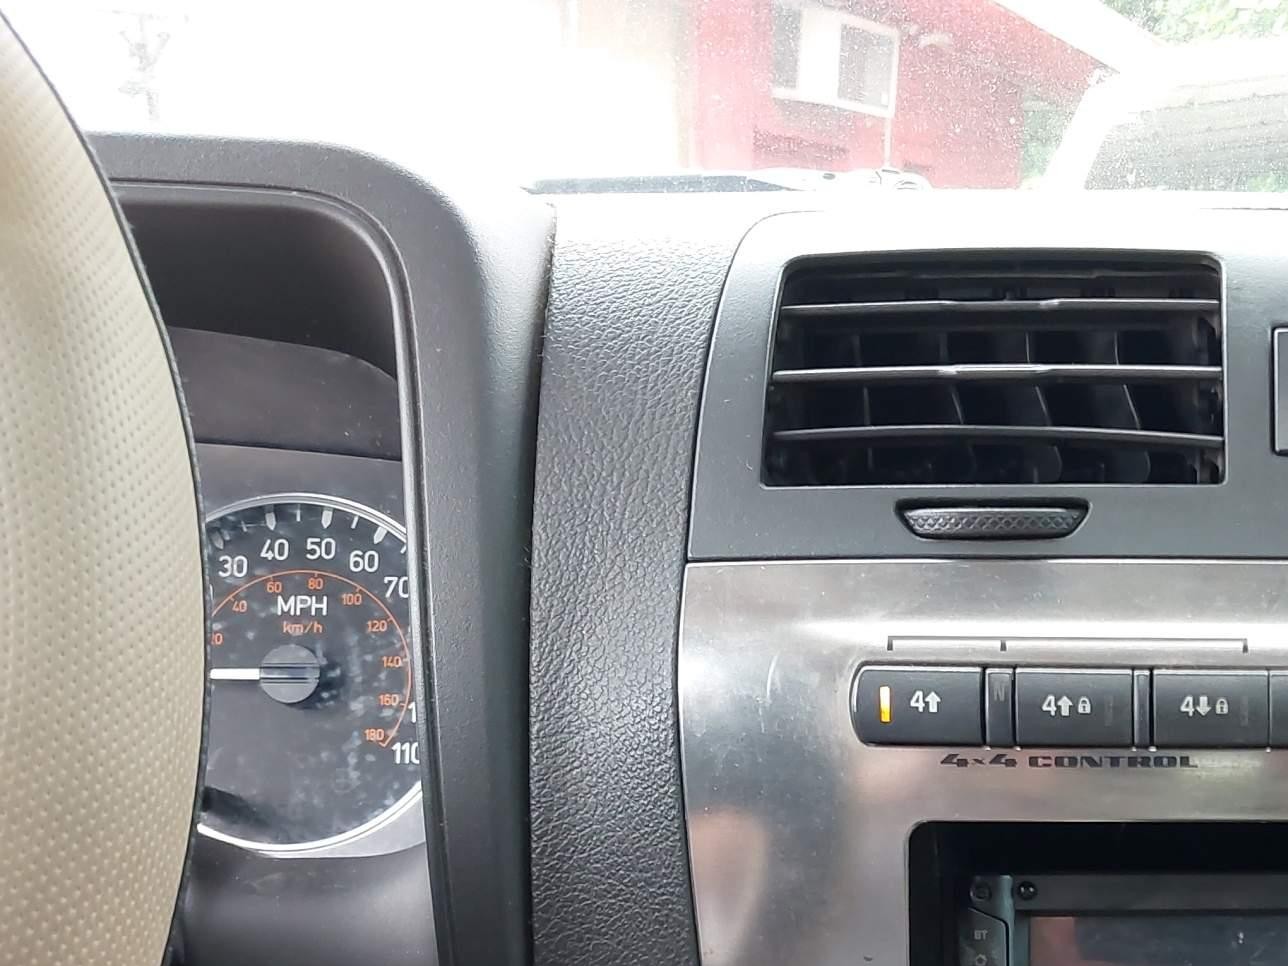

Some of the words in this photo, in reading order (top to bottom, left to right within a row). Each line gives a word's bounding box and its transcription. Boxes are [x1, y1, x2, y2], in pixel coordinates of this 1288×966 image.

[260, 538, 289, 561] 40
[306, 537, 336, 560] 50
[218, 555, 248, 578] 30
[349, 550, 379, 573] 60
[266, 581, 283, 593] 60
[308, 578, 324, 590] 80
[383, 576, 410, 599] 70
[276, 595, 328, 616] MPH
[342, 593, 362, 606] 100
[231, 600, 248, 613] 40
[282, 621, 323, 634] km/h
[366, 620, 388, 633] 120
[381, 655, 402, 668] 140
[377, 693, 400, 706] 160
[363, 728, 385, 742] 180
[1027, 755, 1199, 769] CONTROL
